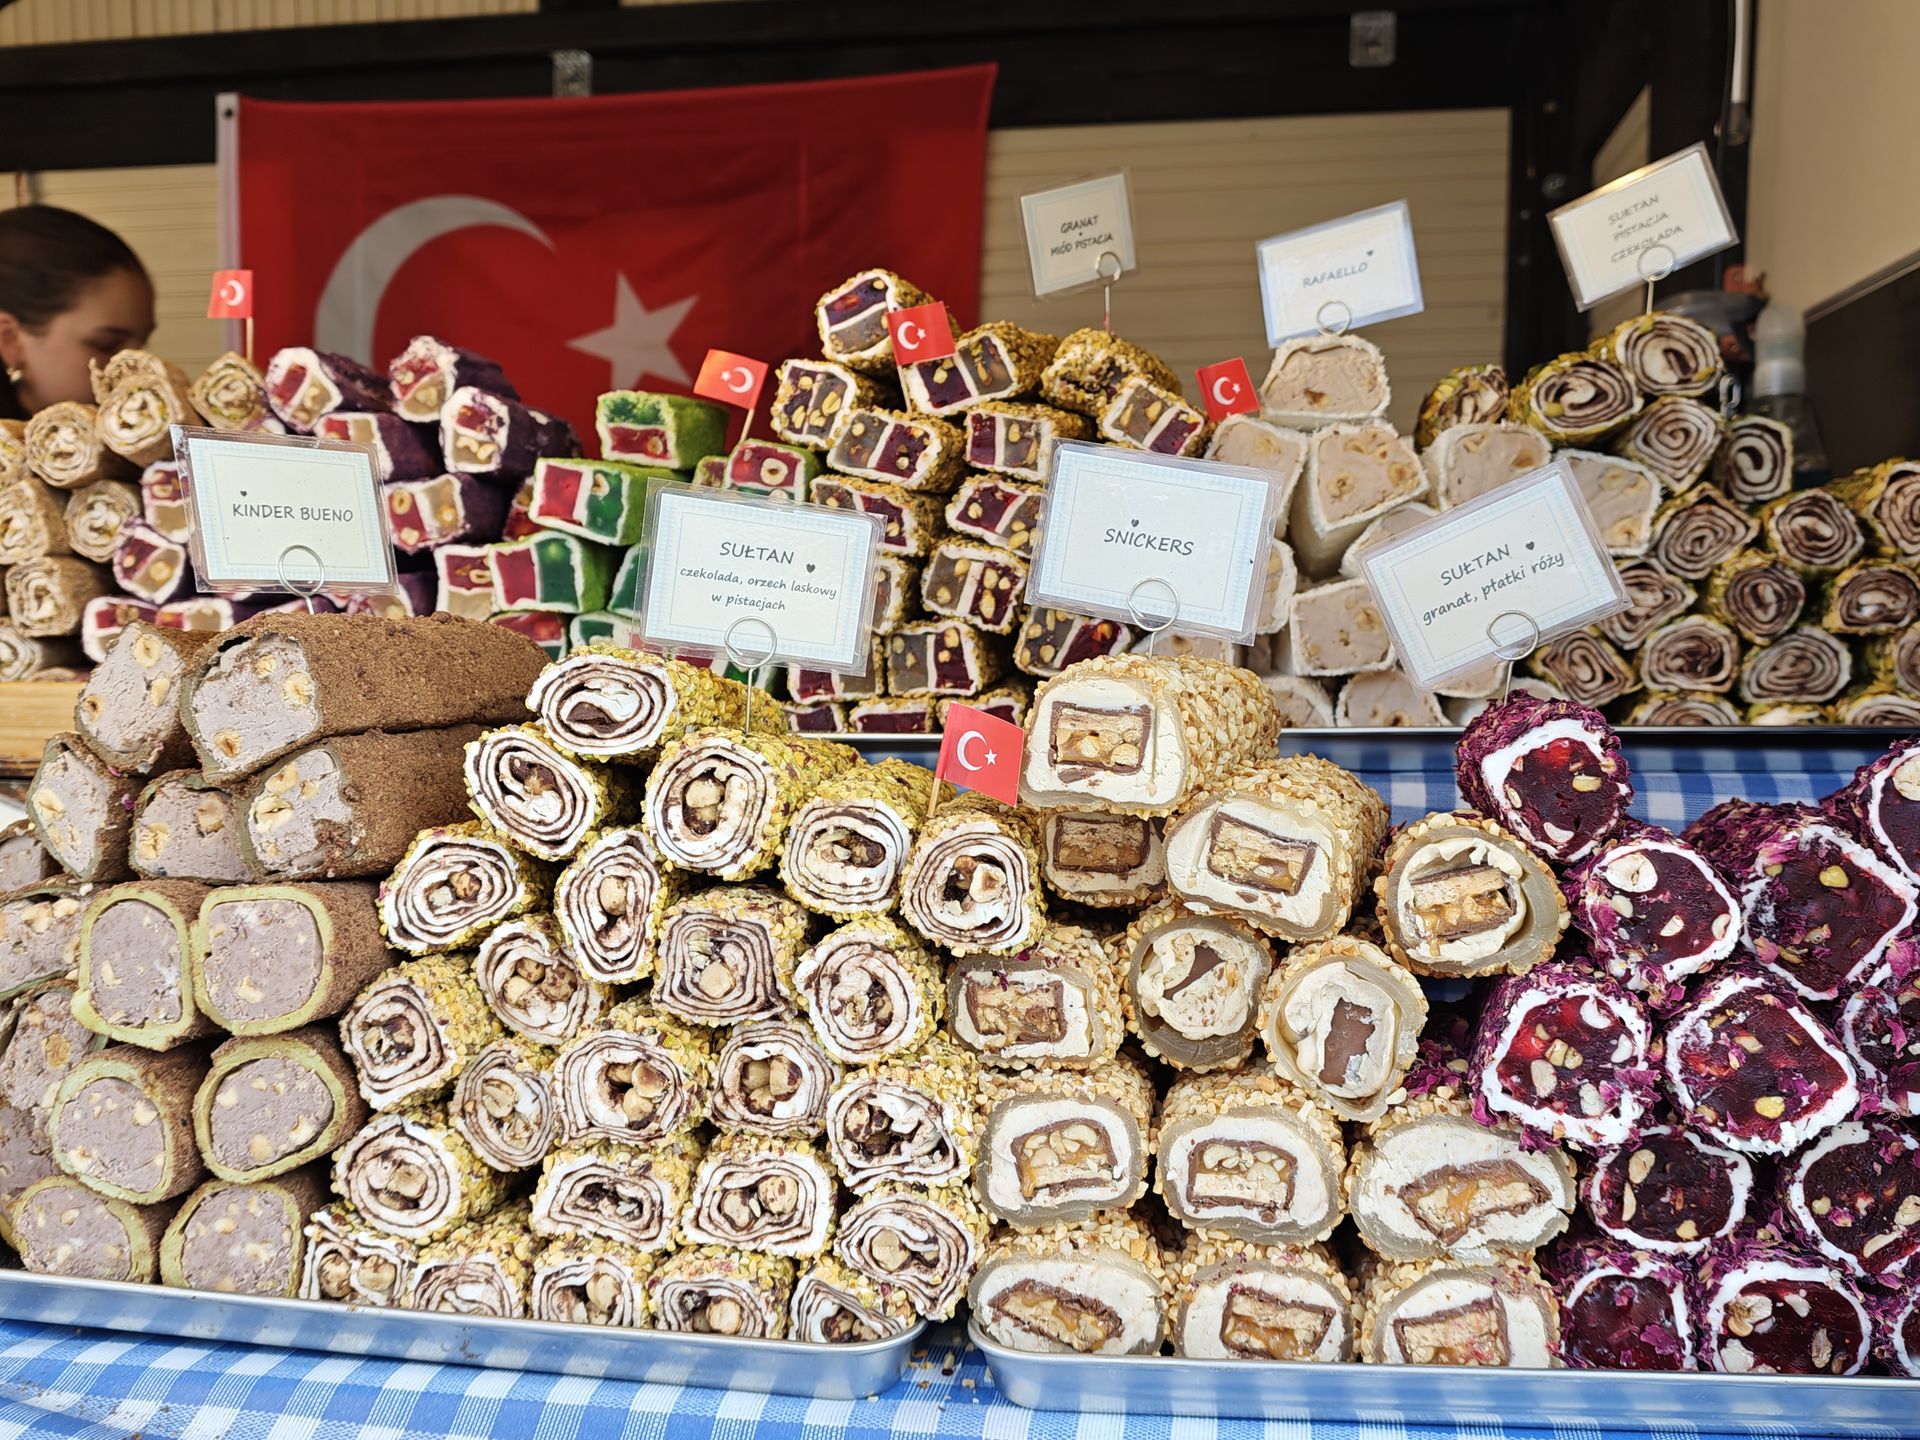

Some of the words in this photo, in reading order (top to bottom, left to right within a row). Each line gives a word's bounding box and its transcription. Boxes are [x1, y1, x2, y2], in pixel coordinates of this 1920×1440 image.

[1061, 215, 1099, 234] GRANAT
[1303, 262, 1368, 288] RAFAELLO
[233, 504, 295, 519] KINDER
[300, 507, 353, 522] BUENO
[720, 542, 794, 564] SUŁTAN
[1104, 528, 1194, 556] SNICKERS
[1441, 544, 1511, 586] SUŁTAN
[680, 567, 743, 585] czekolada,
[748, 577, 787, 589] orzech
[791, 581, 837, 600] laskowy
[1423, 591, 1478, 625] granat,
[1481, 565, 1526, 600] płatki
[1531, 552, 1565, 575] róży
[711, 594, 722, 602] w
[725, 594, 786, 611] pistacjach
